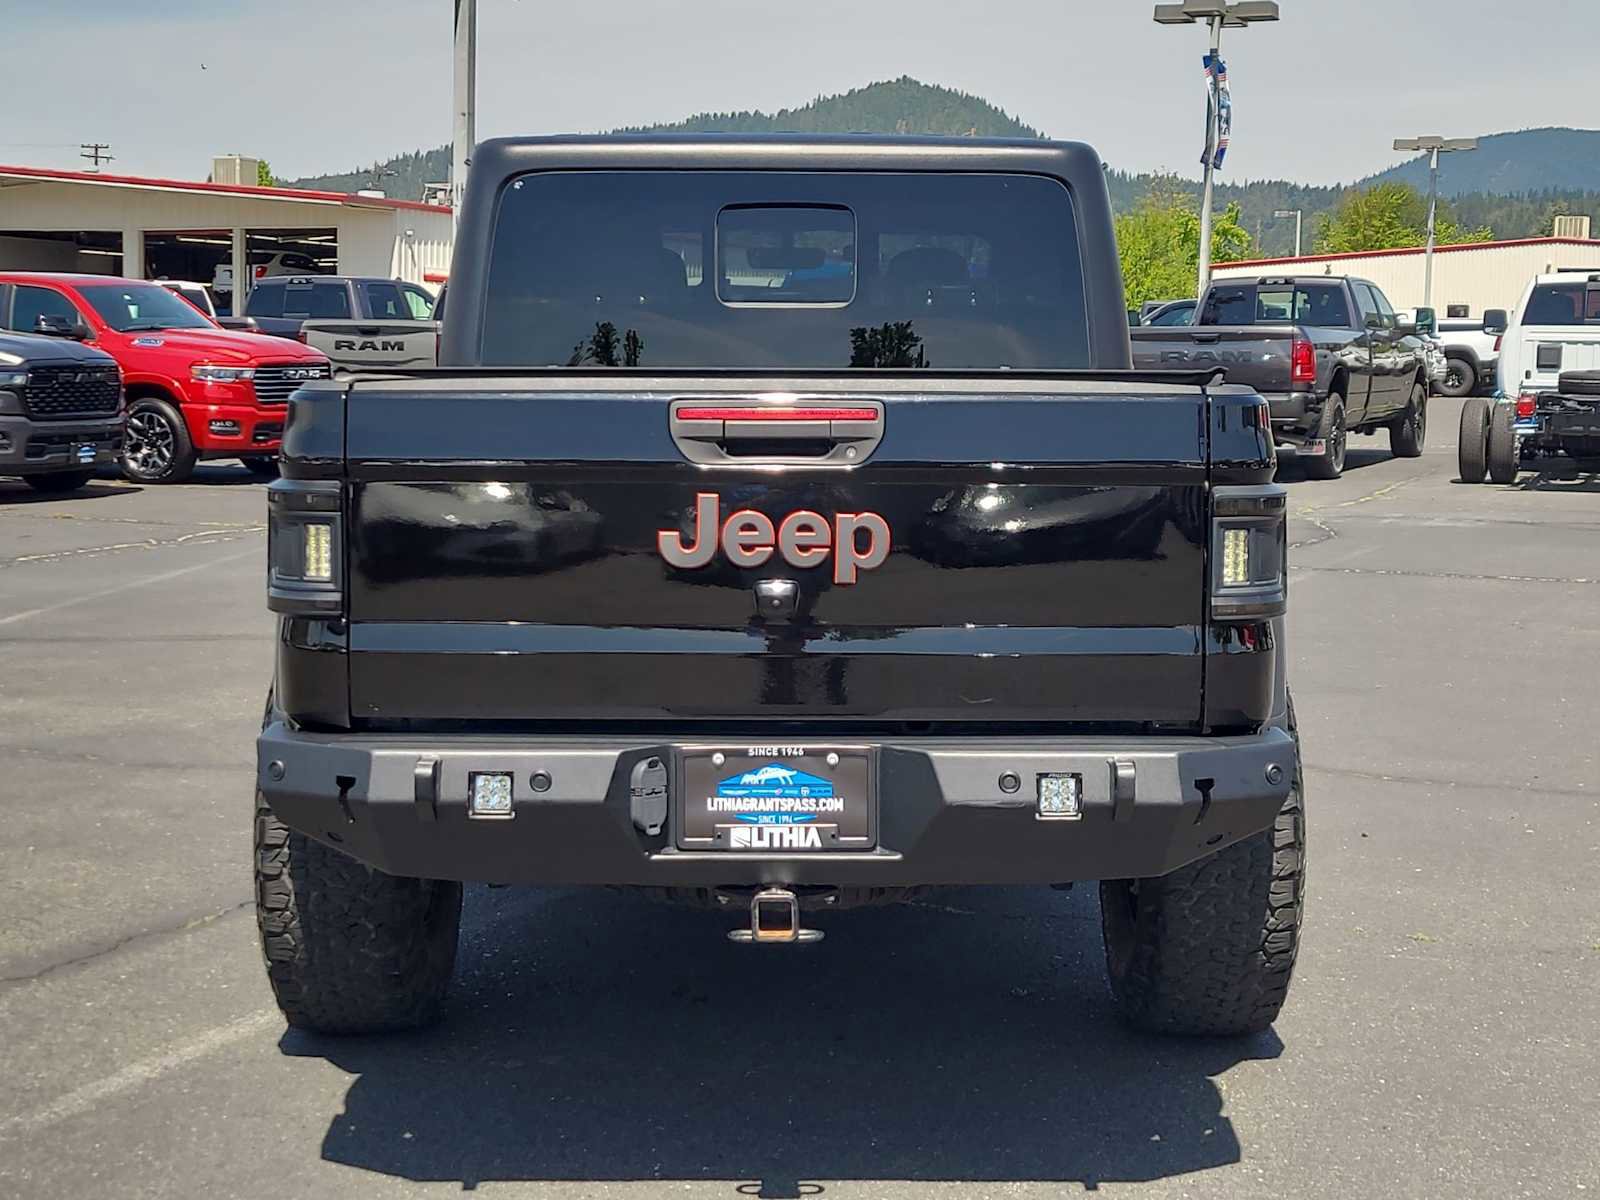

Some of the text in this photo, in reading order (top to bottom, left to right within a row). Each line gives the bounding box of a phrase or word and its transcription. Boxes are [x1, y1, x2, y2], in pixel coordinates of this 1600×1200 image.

[335, 340, 405, 351] RAM
[1160, 351, 1252, 362] RAM
[657, 491, 891, 586] Jeep
[748, 747, 804, 757] SINCE 1946
[706, 798, 845, 812] LITHIAGRANTSPASS.COM
[758, 815, 777, 824] SINCE
[751, 826, 823, 849] LITHIA
